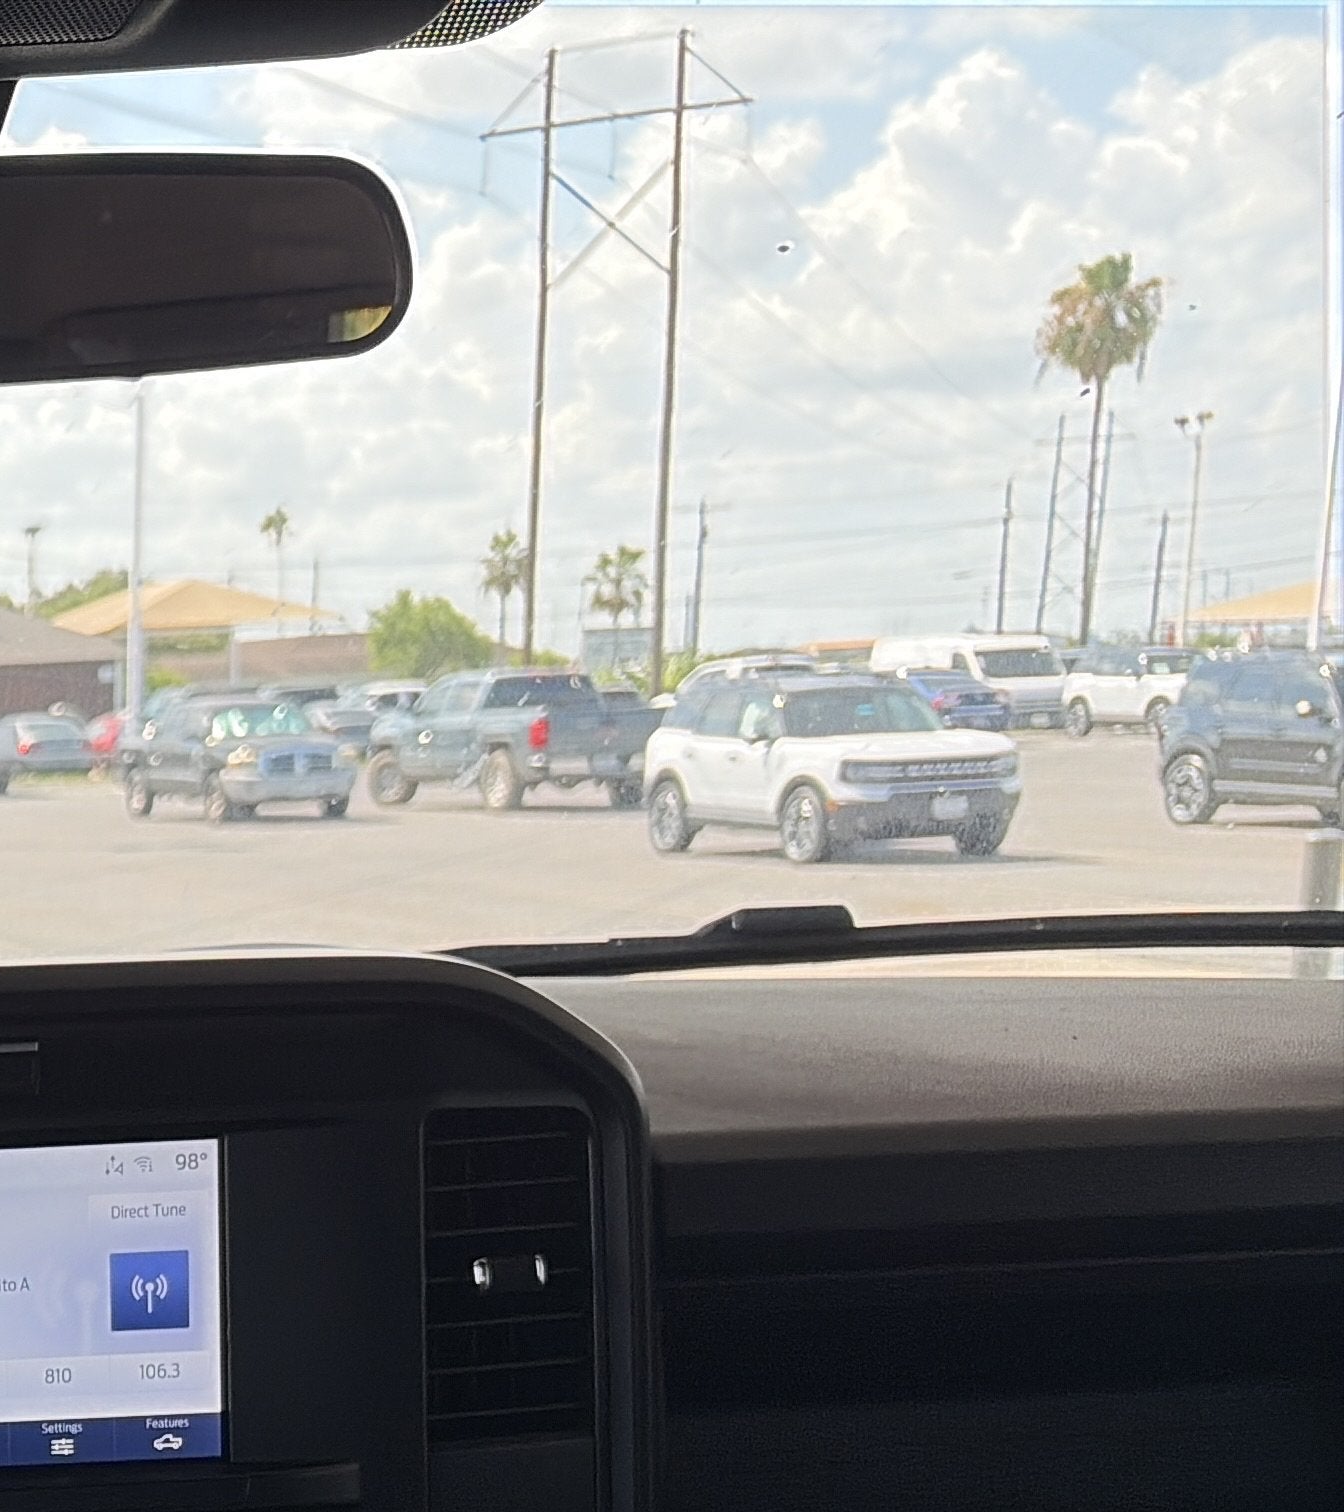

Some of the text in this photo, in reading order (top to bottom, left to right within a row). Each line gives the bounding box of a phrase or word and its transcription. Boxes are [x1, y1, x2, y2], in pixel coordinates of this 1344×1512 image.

[175, 1152, 208, 1170] 98°
[111, 1203, 187, 1220] Direct Tune
[20, 1277, 30, 1291] A
[44, 1368, 72, 1384] 810
[139, 1363, 180, 1380] 106.3
[41, 1423, 83, 1436] Settings
[146, 1418, 189, 1430] Features
